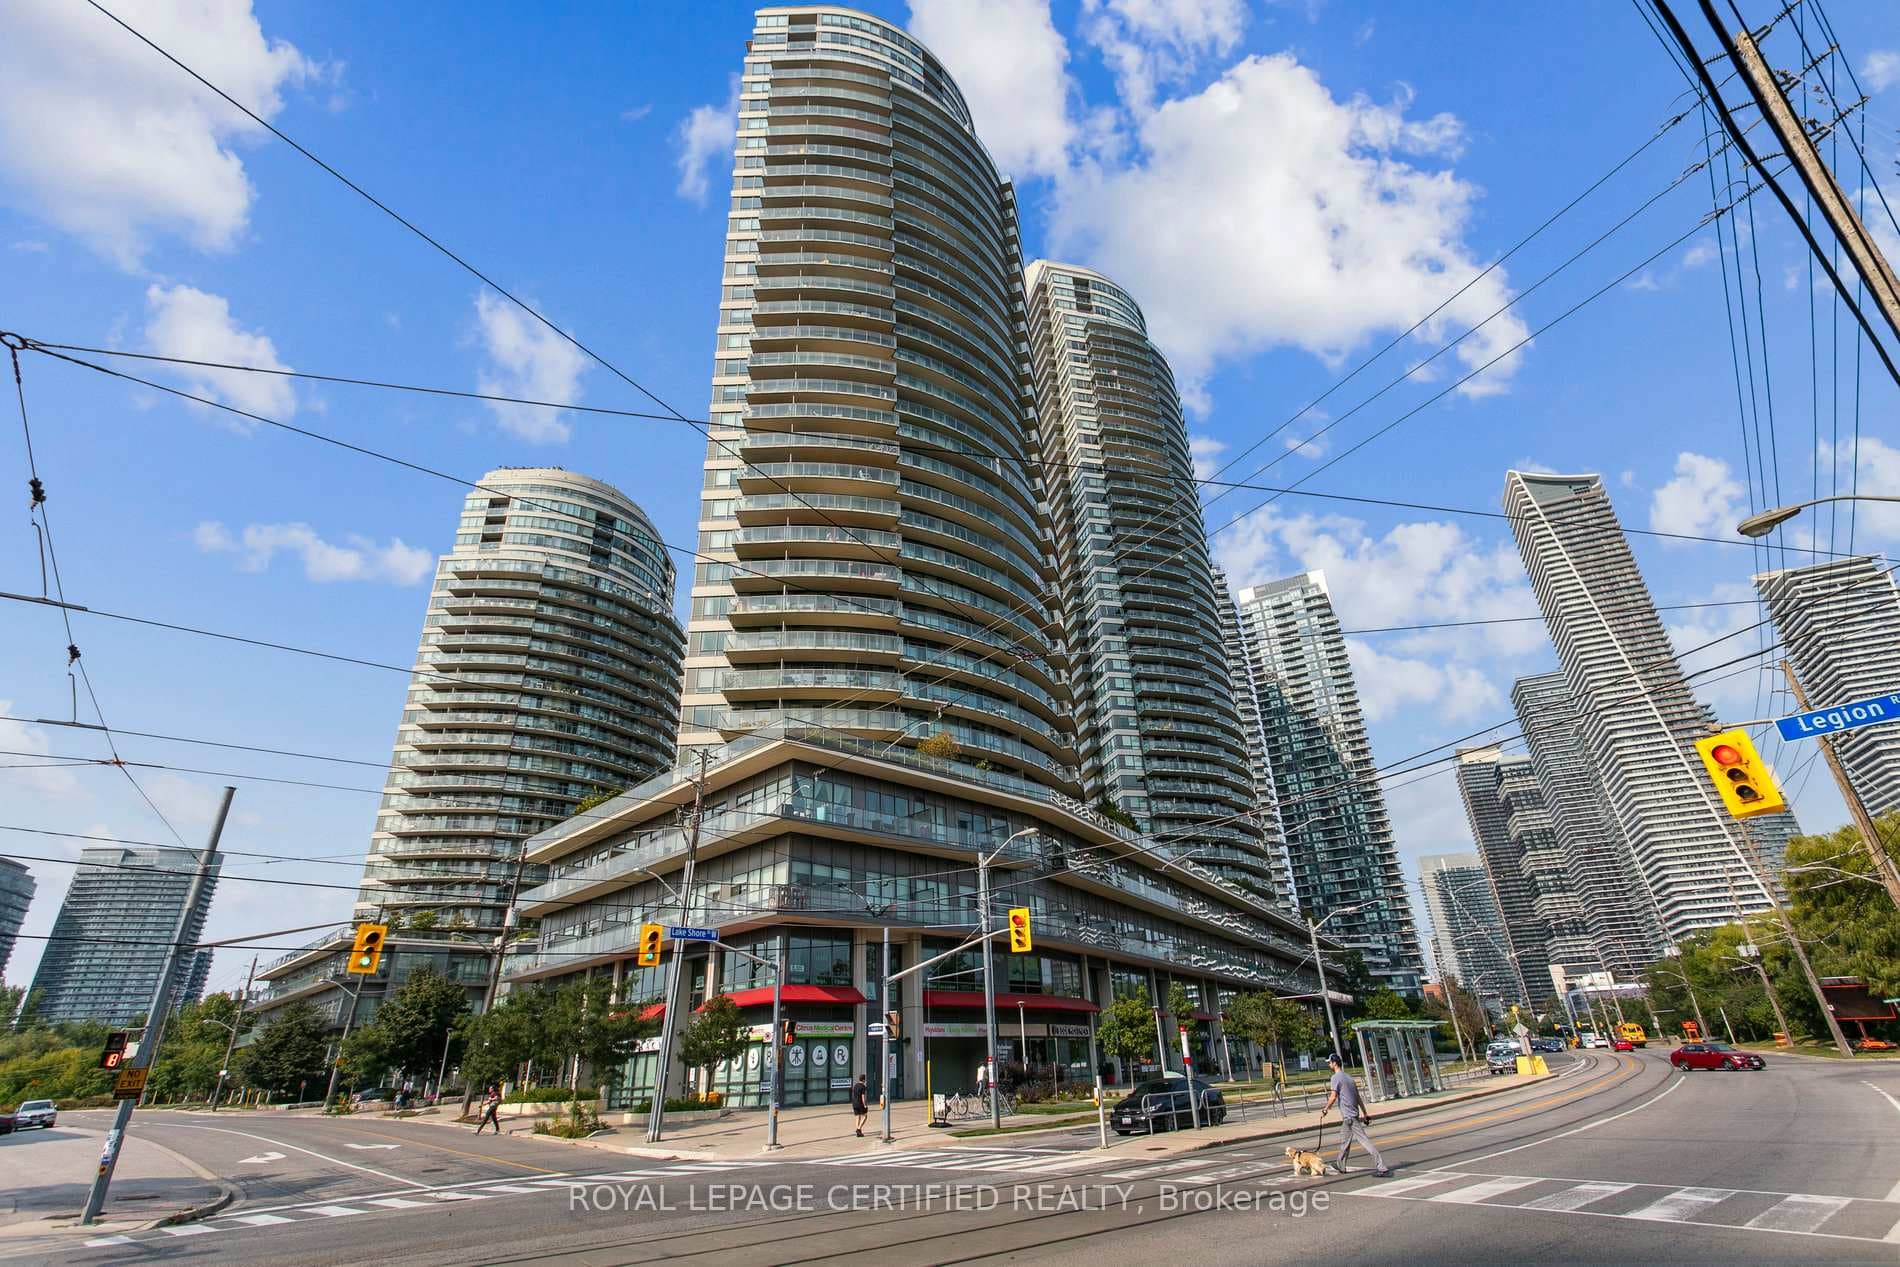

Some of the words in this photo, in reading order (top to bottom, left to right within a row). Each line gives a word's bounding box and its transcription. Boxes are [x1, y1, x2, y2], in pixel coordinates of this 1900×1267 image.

[1797, 703, 1885, 732] Legion
[672, 928, 687, 937] Lake
[687, 928, 706, 938] Shore
[107, 1053, 119, 1067] 8
[127, 1070, 141, 1078] NO
[120, 1080, 141, 1088] EXIT
